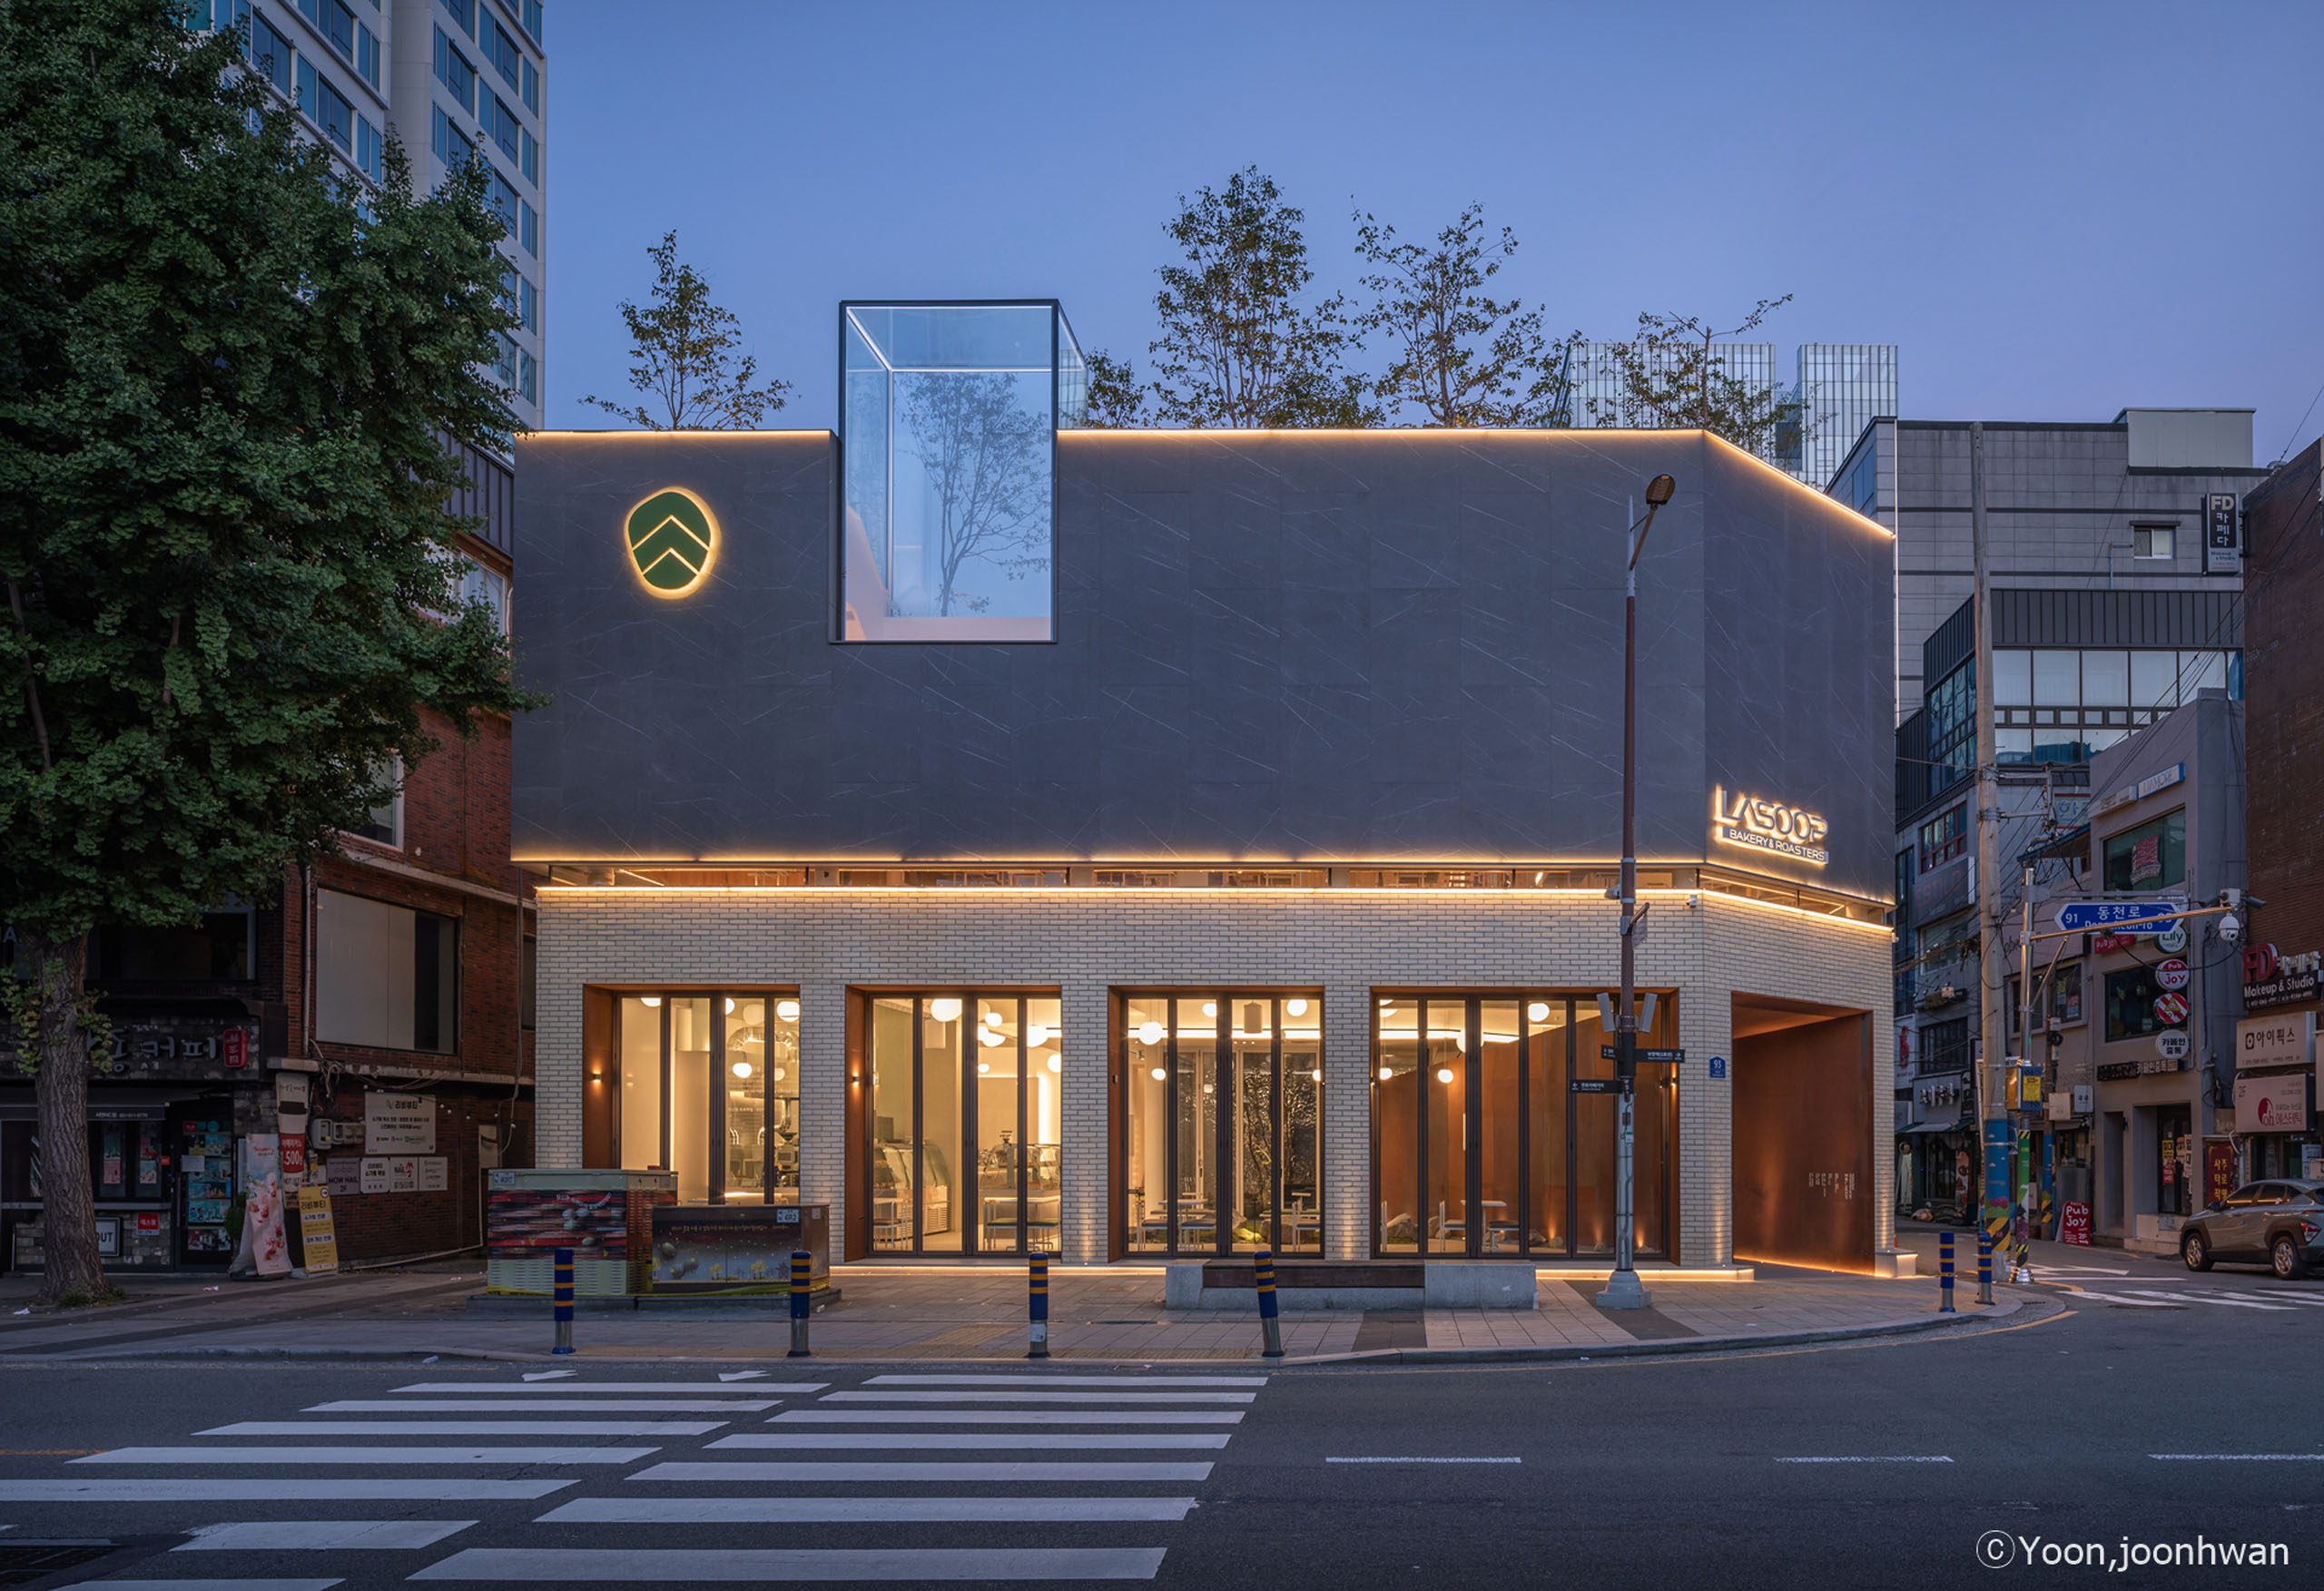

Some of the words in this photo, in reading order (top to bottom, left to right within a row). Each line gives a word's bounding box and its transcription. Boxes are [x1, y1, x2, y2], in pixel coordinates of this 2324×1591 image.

[2211, 496, 2235, 511] FD
[1728, 828, 1768, 848] BAKERY
[1775, 840, 1826, 861] ROASTERS
[2064, 912, 2079, 924] 91
[2097, 906, 2142, 920] 동천로
[2242, 943, 2280, 984] FD
[2243, 983, 2278, 997] Makeup
[2279, 979, 2285, 992] &
[2287, 974, 2315, 991] Studio
[2256, 1027, 2296, 1048] 아이픽스
[2065, 1204, 2089, 1217] Pub
